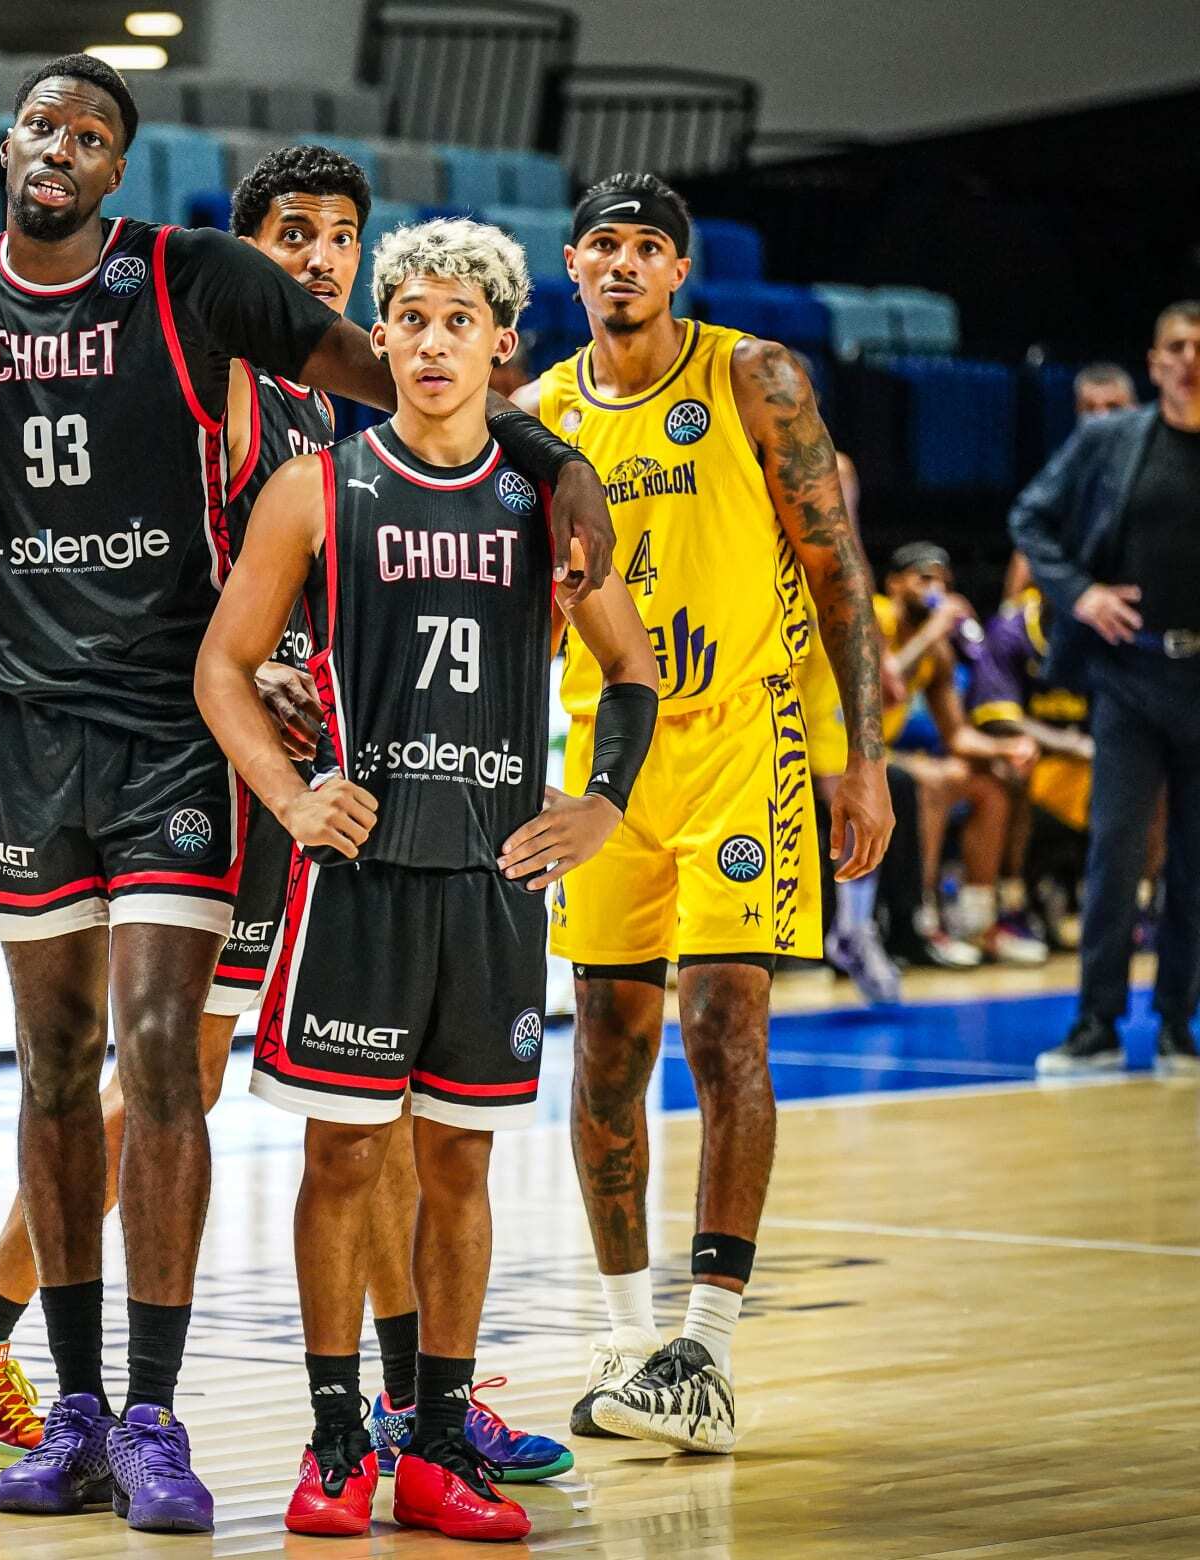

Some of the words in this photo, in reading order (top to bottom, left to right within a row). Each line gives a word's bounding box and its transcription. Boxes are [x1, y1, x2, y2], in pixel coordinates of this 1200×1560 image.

[22, 413, 92, 489] 93
[602, 480, 640, 506] OEL
[642, 460, 698, 497] HOLON
[10, 521, 170, 570] solengie
[376, 524, 518, 588] CHOLET
[625, 529, 659, 597] 4
[414, 615, 481, 694] 79
[385, 733, 524, 789] solengie
[3, 865, 39, 879] Façades
[230, 919, 274, 942] LLET
[239, 943, 271, 955] Façade
[301, 1035, 345, 1056] Fenêtres
[347, 1046, 360, 1058] et
[361, 1047, 405, 1062] Façades
[303, 1013, 409, 1050] MILLET
